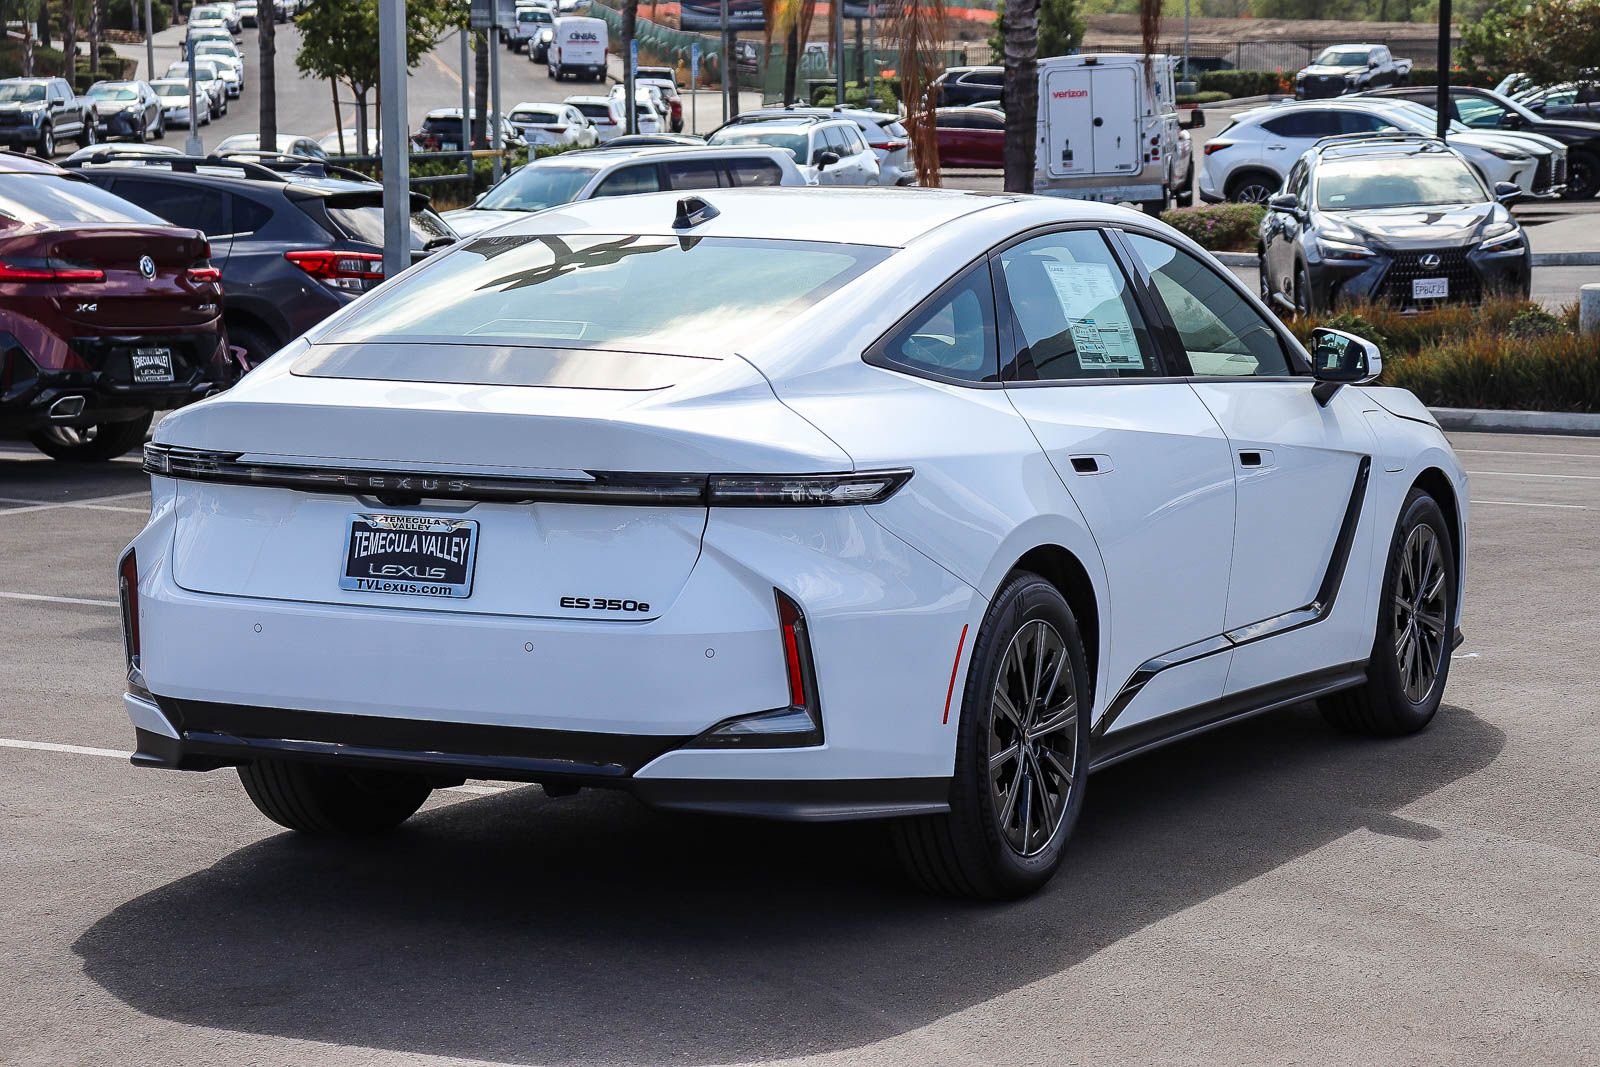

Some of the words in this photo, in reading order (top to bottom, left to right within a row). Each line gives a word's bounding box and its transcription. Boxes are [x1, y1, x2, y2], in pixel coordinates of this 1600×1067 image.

[1052, 89, 1088, 99] verizon
[76, 303, 98, 312] X4
[344, 475, 466, 492] LEXUS
[383, 515, 441, 526] TEMECULA
[391, 522, 431, 532] VALLEY
[354, 531, 419, 559] TEMECULA
[421, 535, 470, 566] VALLEY
[369, 563, 447, 579] LEXUS
[356, 578, 452, 595] TVLexus.com
[560, 597, 591, 609] ES
[592, 599, 650, 612] 350e
